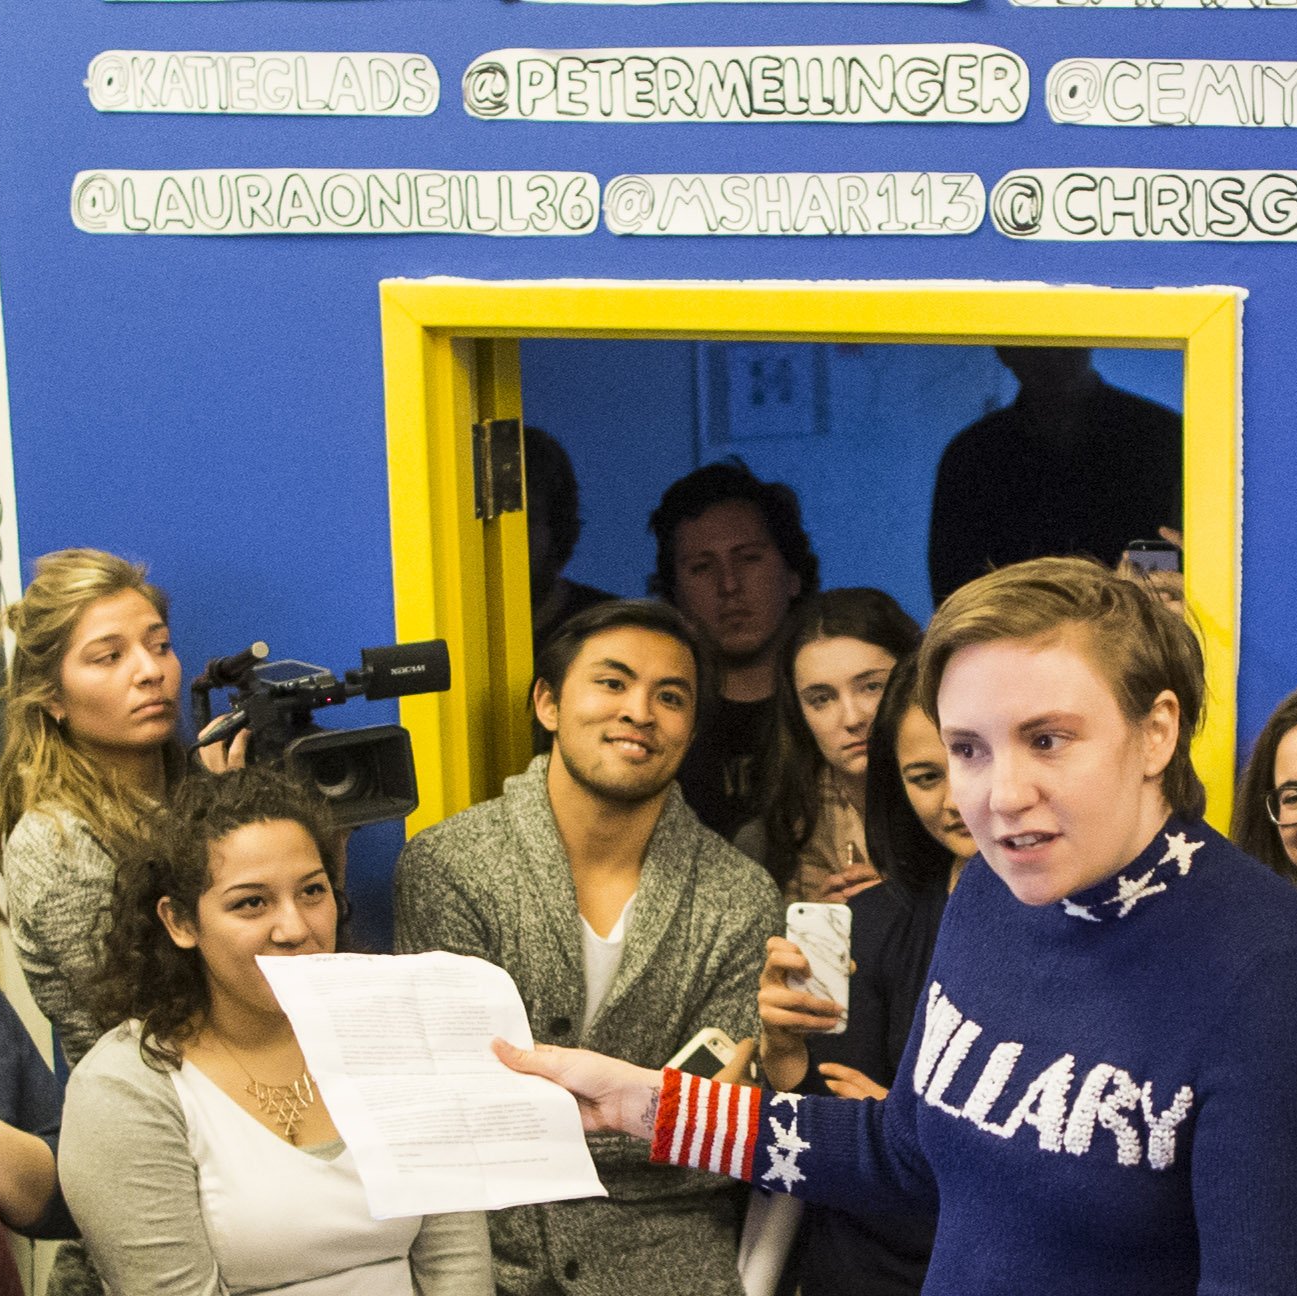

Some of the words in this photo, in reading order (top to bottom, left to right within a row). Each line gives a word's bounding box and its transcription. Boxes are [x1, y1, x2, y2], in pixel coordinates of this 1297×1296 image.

[90, 54, 436, 113] @KATIEGLADS
[464, 53, 1022, 118] @PETERMELLINGER
[73, 172, 594, 231] @LAURAONEILL36
[605, 172, 980, 235] @MSHAR113
[912, 980, 1194, 1170] ILLARY
